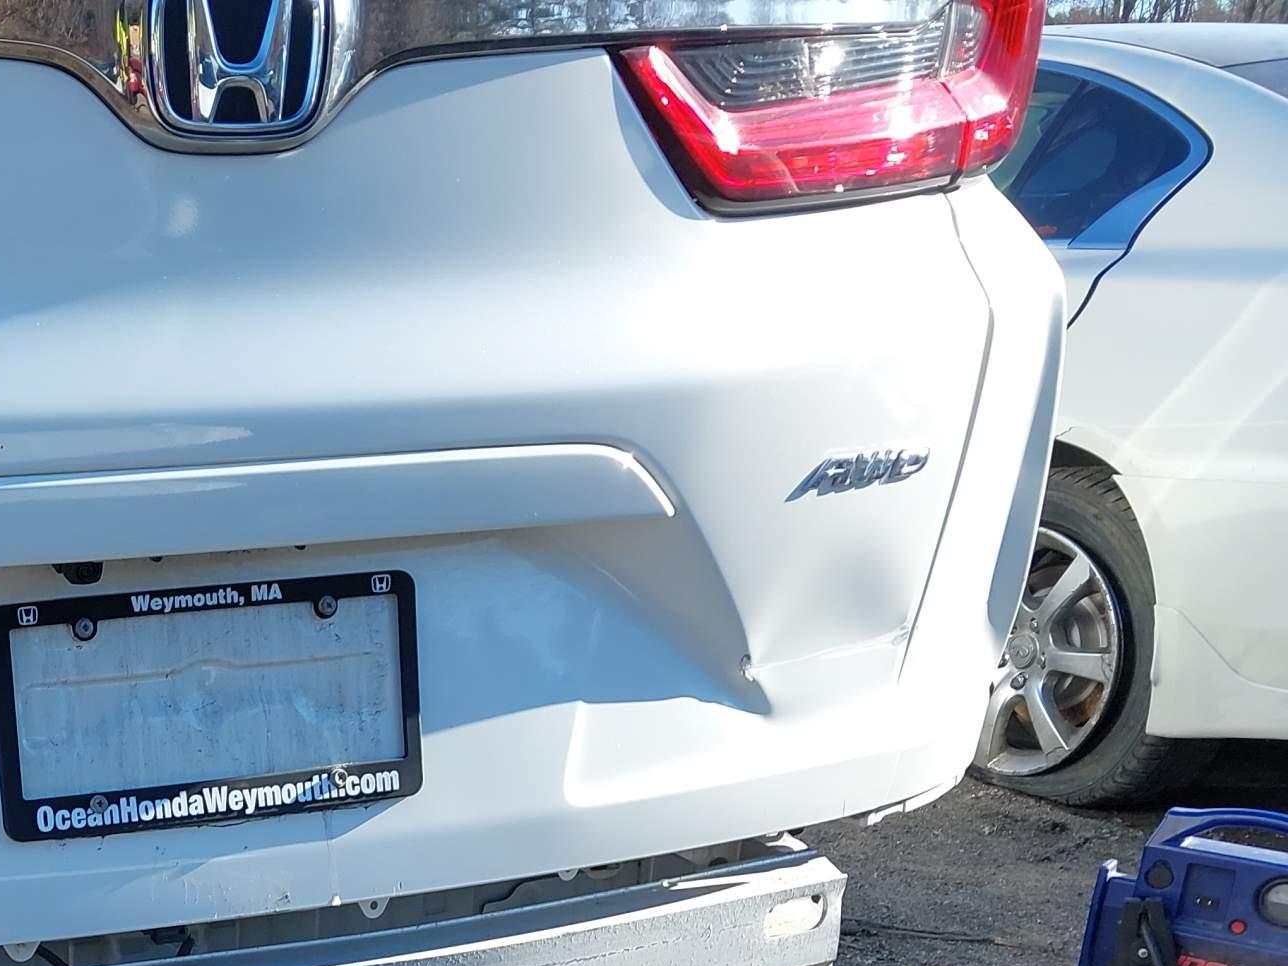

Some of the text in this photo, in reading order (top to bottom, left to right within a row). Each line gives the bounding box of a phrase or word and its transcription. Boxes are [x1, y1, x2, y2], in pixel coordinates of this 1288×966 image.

[130, 583, 283, 613] Weymouth, MA
[36, 768, 400, 833] OceanHondaWeymouth.com
